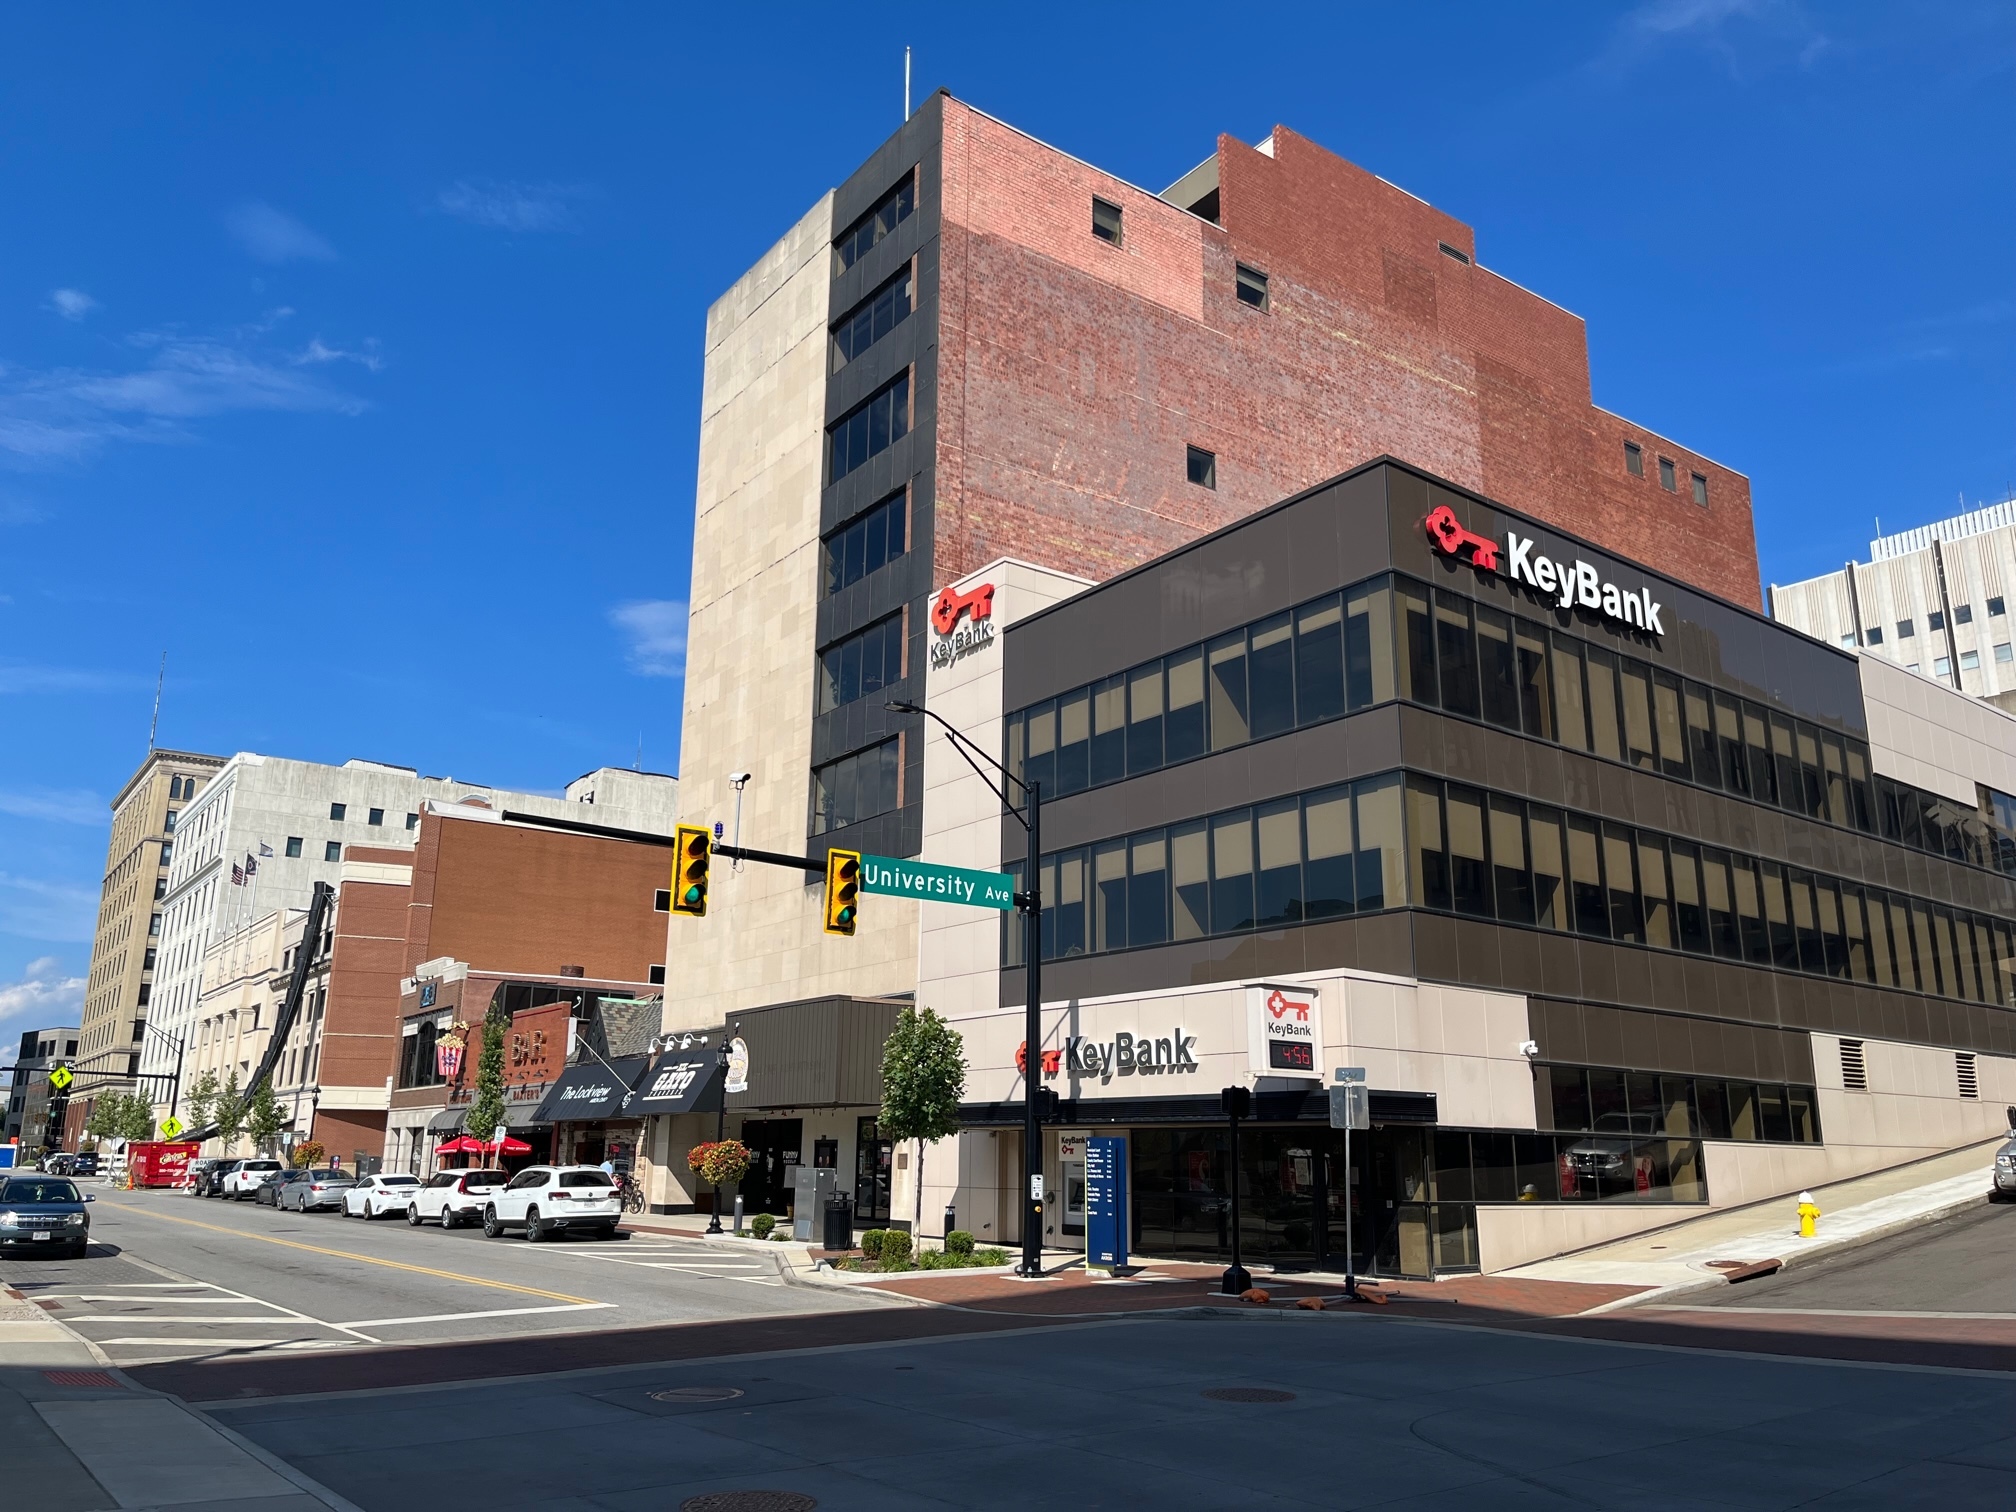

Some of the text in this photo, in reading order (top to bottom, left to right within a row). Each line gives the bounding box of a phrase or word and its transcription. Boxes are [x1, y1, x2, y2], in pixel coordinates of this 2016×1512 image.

[1507, 531, 1665, 636] KeyBank
[931, 620, 994, 662] KeyBank
[865, 864, 1009, 901] University Ave
[511, 1029, 544, 1060] BAR
[1268, 1022, 1312, 1037] KeyBank
[1066, 1028, 1198, 1077] KeyBank
[560, 1086, 576, 1100] The
[651, 1071, 696, 1091] GATO
[1061, 1136, 1086, 1145] KeyBank
